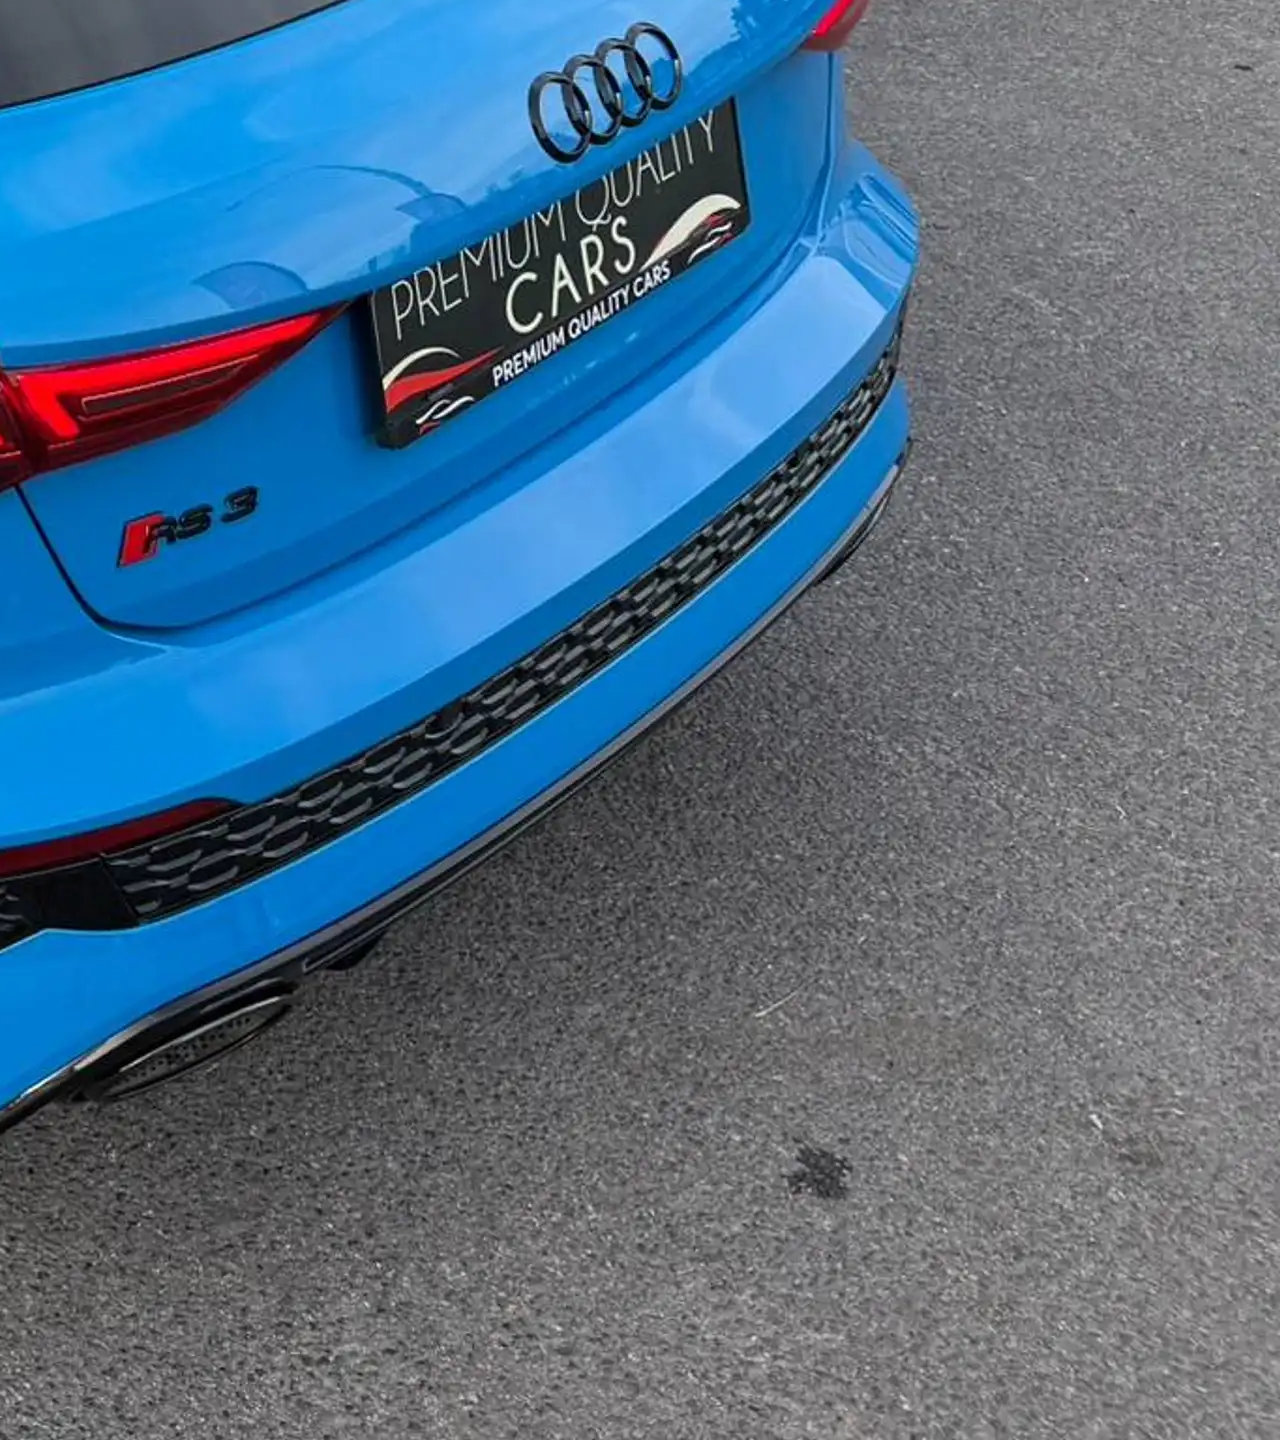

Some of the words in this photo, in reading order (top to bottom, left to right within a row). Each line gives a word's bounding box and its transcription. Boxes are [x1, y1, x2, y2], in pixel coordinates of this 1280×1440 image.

[390, 199, 567, 341] PREMIUM
[491, 332, 566, 388] PREMIUM
[568, 287, 632, 339] QUALITY
[632, 259, 672, 300] CARS
[505, 215, 637, 334] CARS
